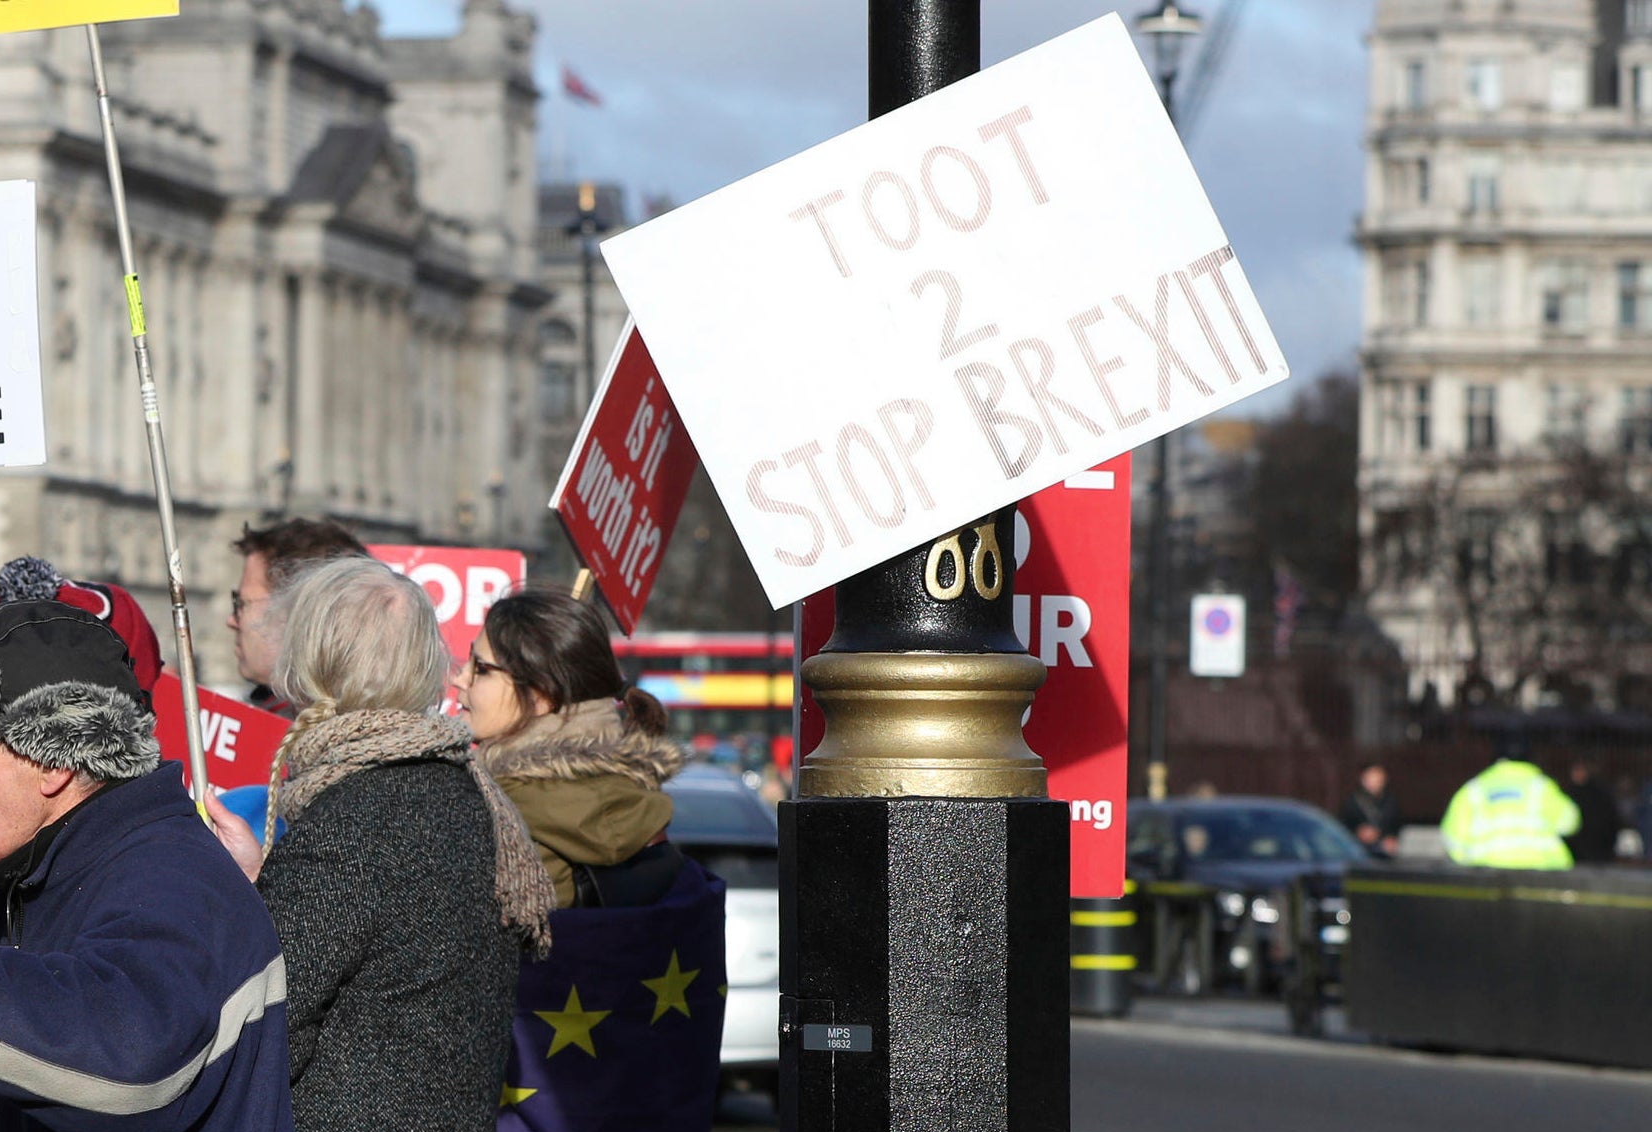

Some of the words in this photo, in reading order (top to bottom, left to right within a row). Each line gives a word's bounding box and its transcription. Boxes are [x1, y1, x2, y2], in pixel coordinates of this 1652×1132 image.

[788, 105, 1050, 278] TOOT
[910, 269, 1000, 361] 2
[624, 377, 654, 462] is
[640, 410, 673, 492] it
[745, 397, 936, 568] STOP
[954, 245, 1268, 480] BREXIT
[576, 436, 636, 560] worth
[619, 505, 662, 598] it?
[827, 1027, 851, 1039] MPS
[827, 1039, 851, 1049] 16632
